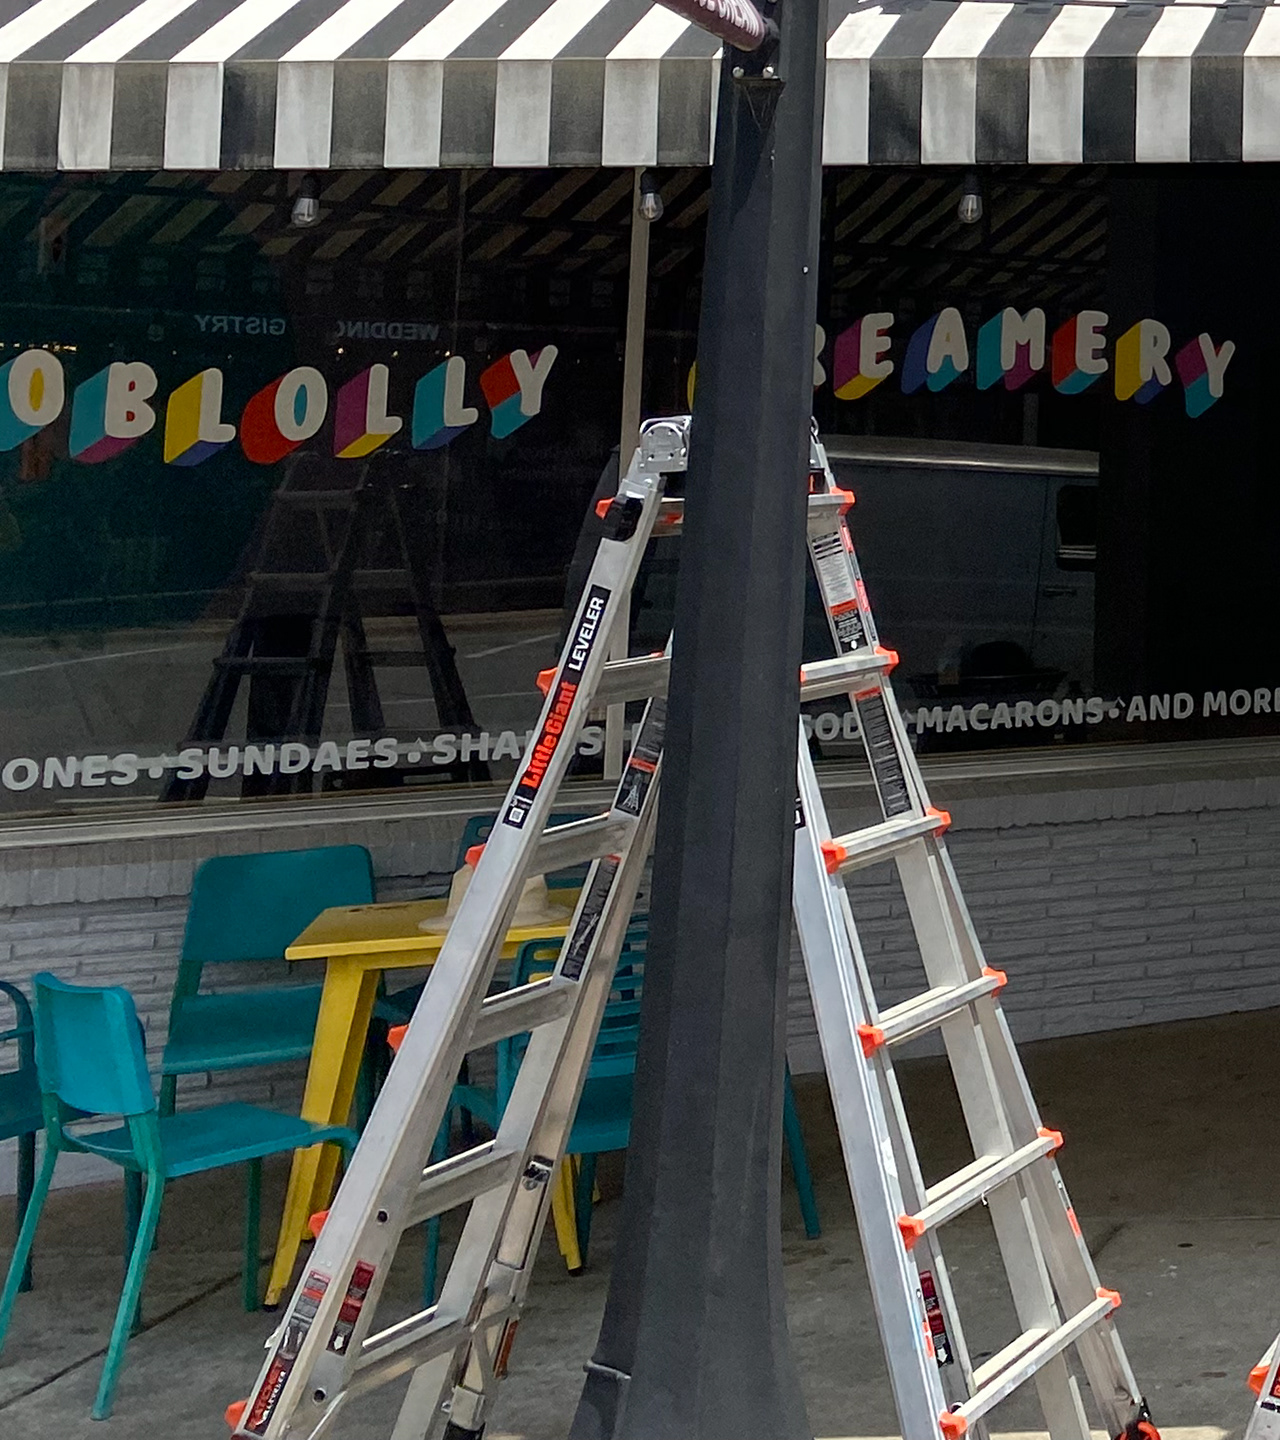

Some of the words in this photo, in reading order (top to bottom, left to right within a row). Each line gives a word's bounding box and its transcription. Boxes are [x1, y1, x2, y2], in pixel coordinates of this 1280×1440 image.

[813, 307, 1236, 420] EAMERY
[568, 596, 604, 672] LEVELER
[176, 738, 400, 779] SUNDAES
[432, 725, 603, 764] SHAS
[916, 697, 1104, 734] MACARONS
[1127, 691, 1195, 723] AND
